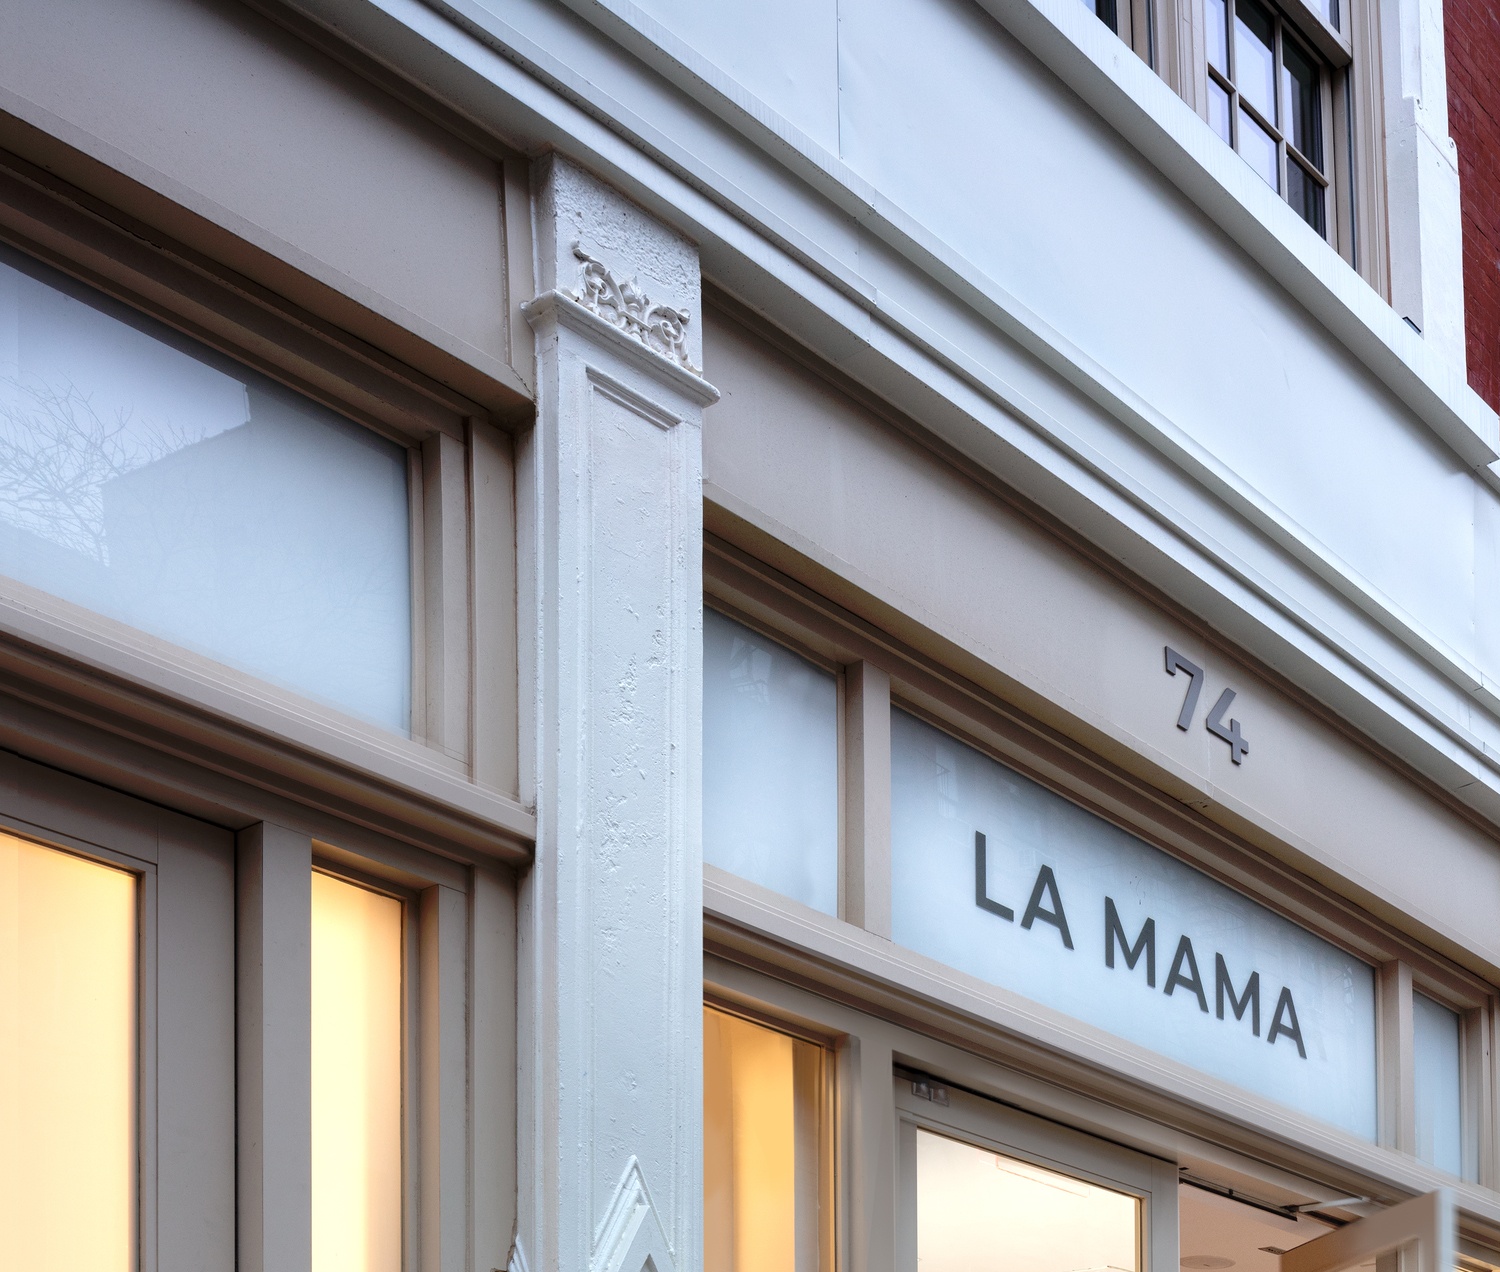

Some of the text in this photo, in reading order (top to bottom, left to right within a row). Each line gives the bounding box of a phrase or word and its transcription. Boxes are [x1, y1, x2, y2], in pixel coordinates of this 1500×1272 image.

[1164, 645, 1249, 766] 74
[975, 830, 1308, 1060] LA MAMA
